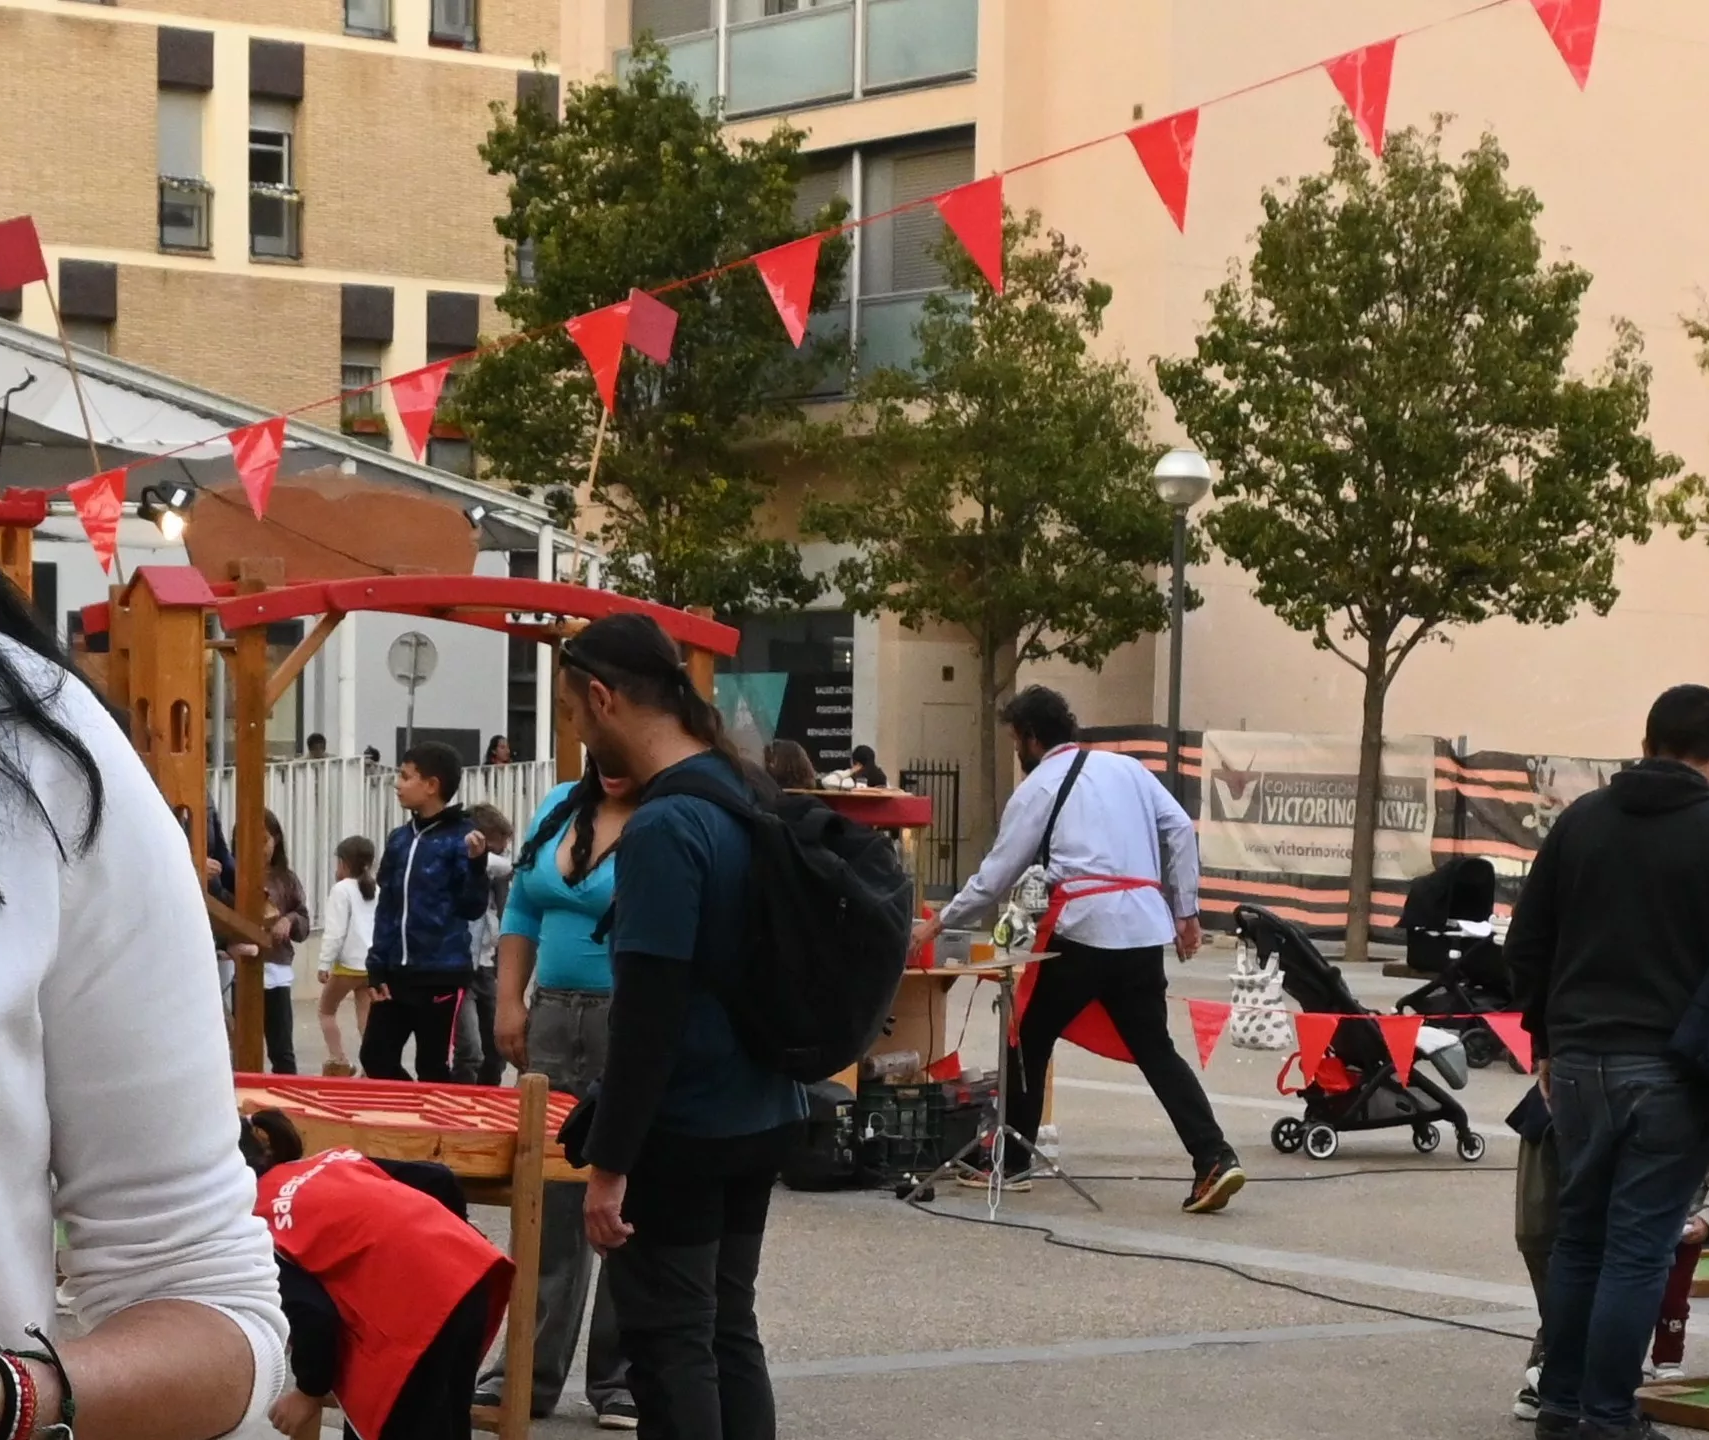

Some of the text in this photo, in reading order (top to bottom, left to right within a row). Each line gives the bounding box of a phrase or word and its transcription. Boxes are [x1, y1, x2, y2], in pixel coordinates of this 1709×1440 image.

[1264, 780, 1357, 797] CONSTRUCCION
[1264, 795, 1426, 830] VICTORINO ICENTE
